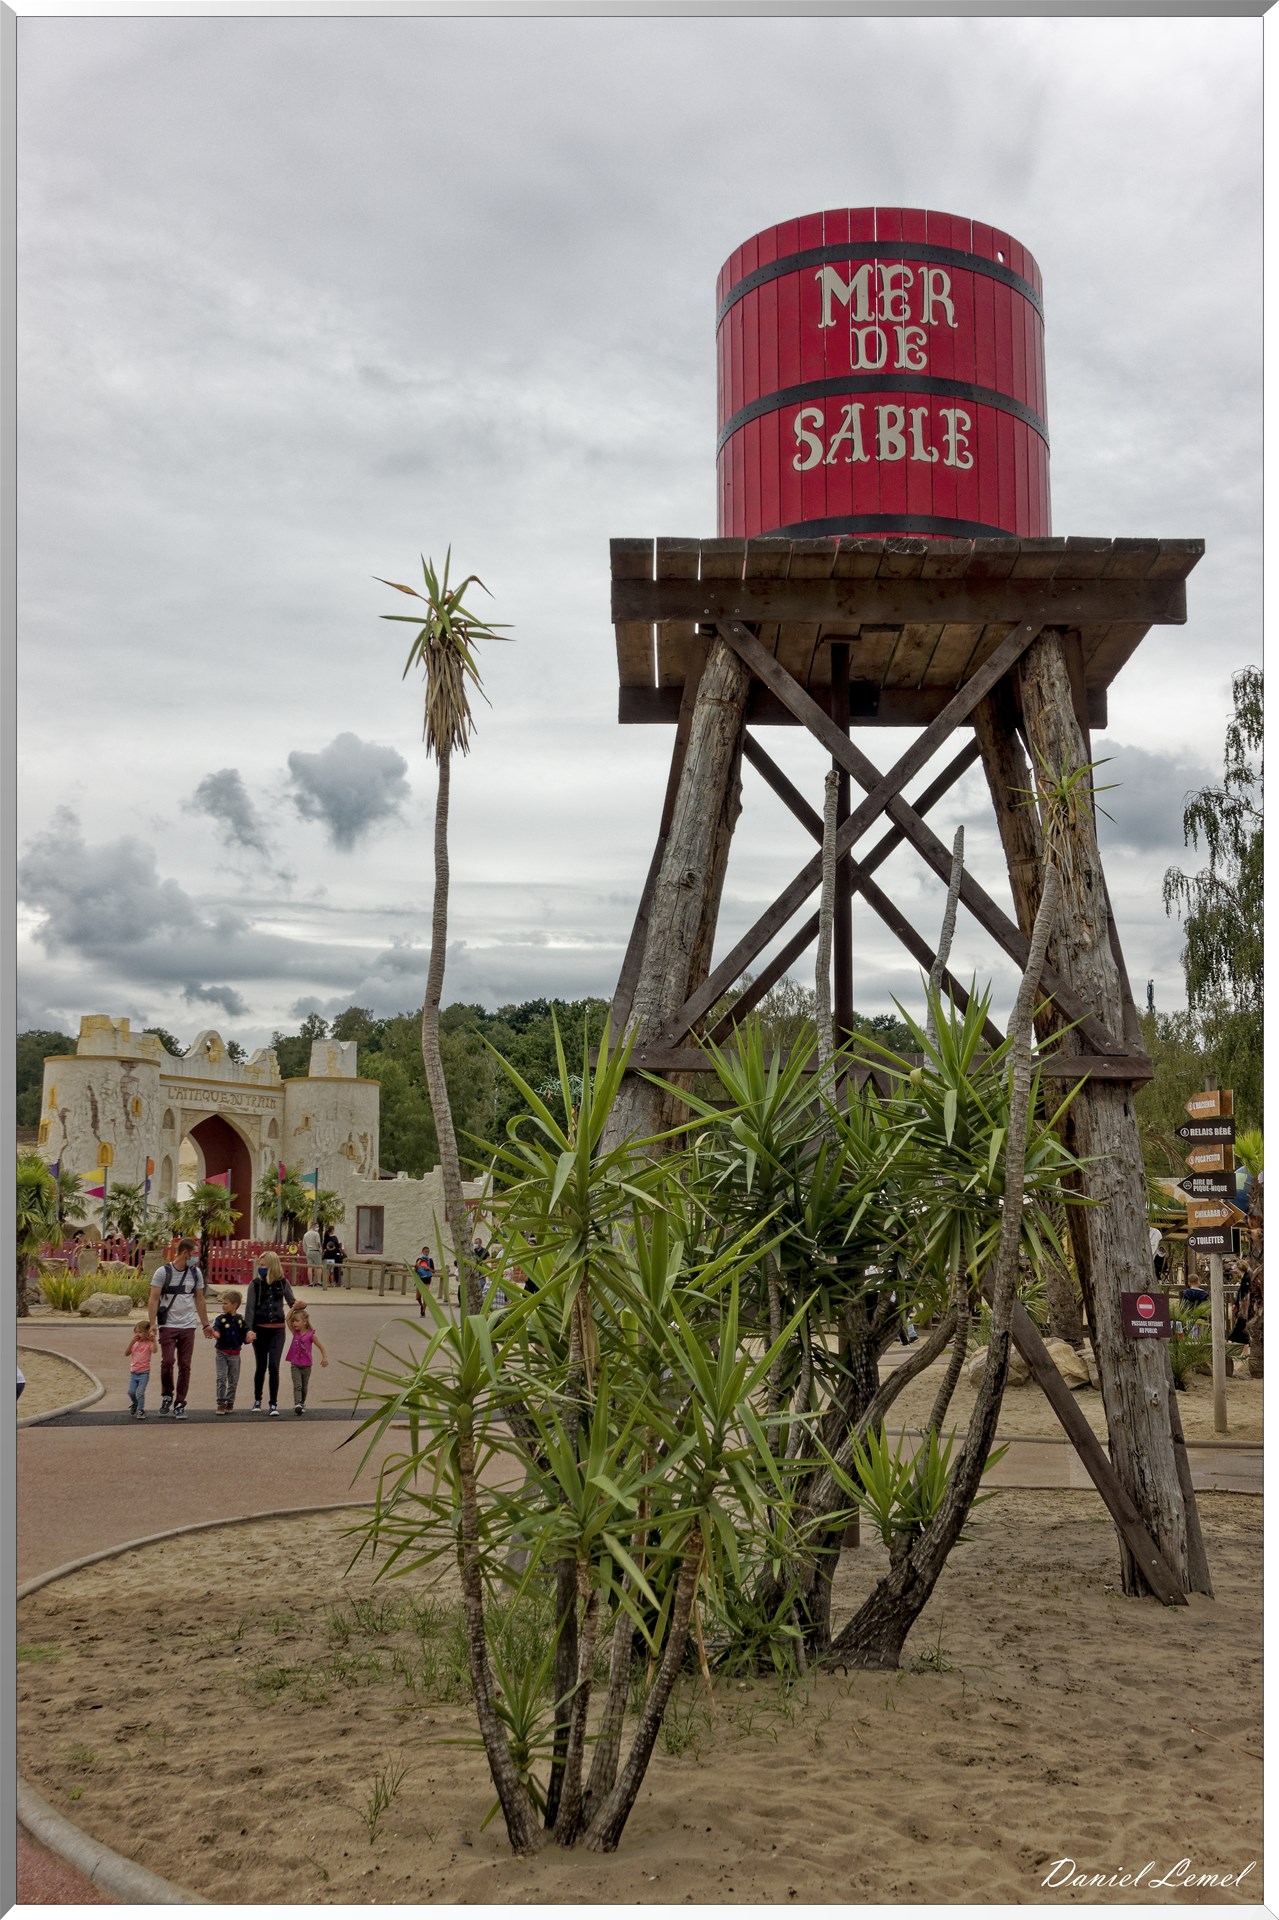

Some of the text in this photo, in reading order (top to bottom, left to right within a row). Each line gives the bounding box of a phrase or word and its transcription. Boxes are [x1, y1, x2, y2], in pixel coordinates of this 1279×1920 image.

[815, 264, 958, 328] MER
[850, 326, 927, 371] DE
[793, 403, 974, 471] SABLE
[1190, 1126, 1232, 1136] RELAIS BÉBÉ
[1196, 1236, 1224, 1244] TOILETTES
